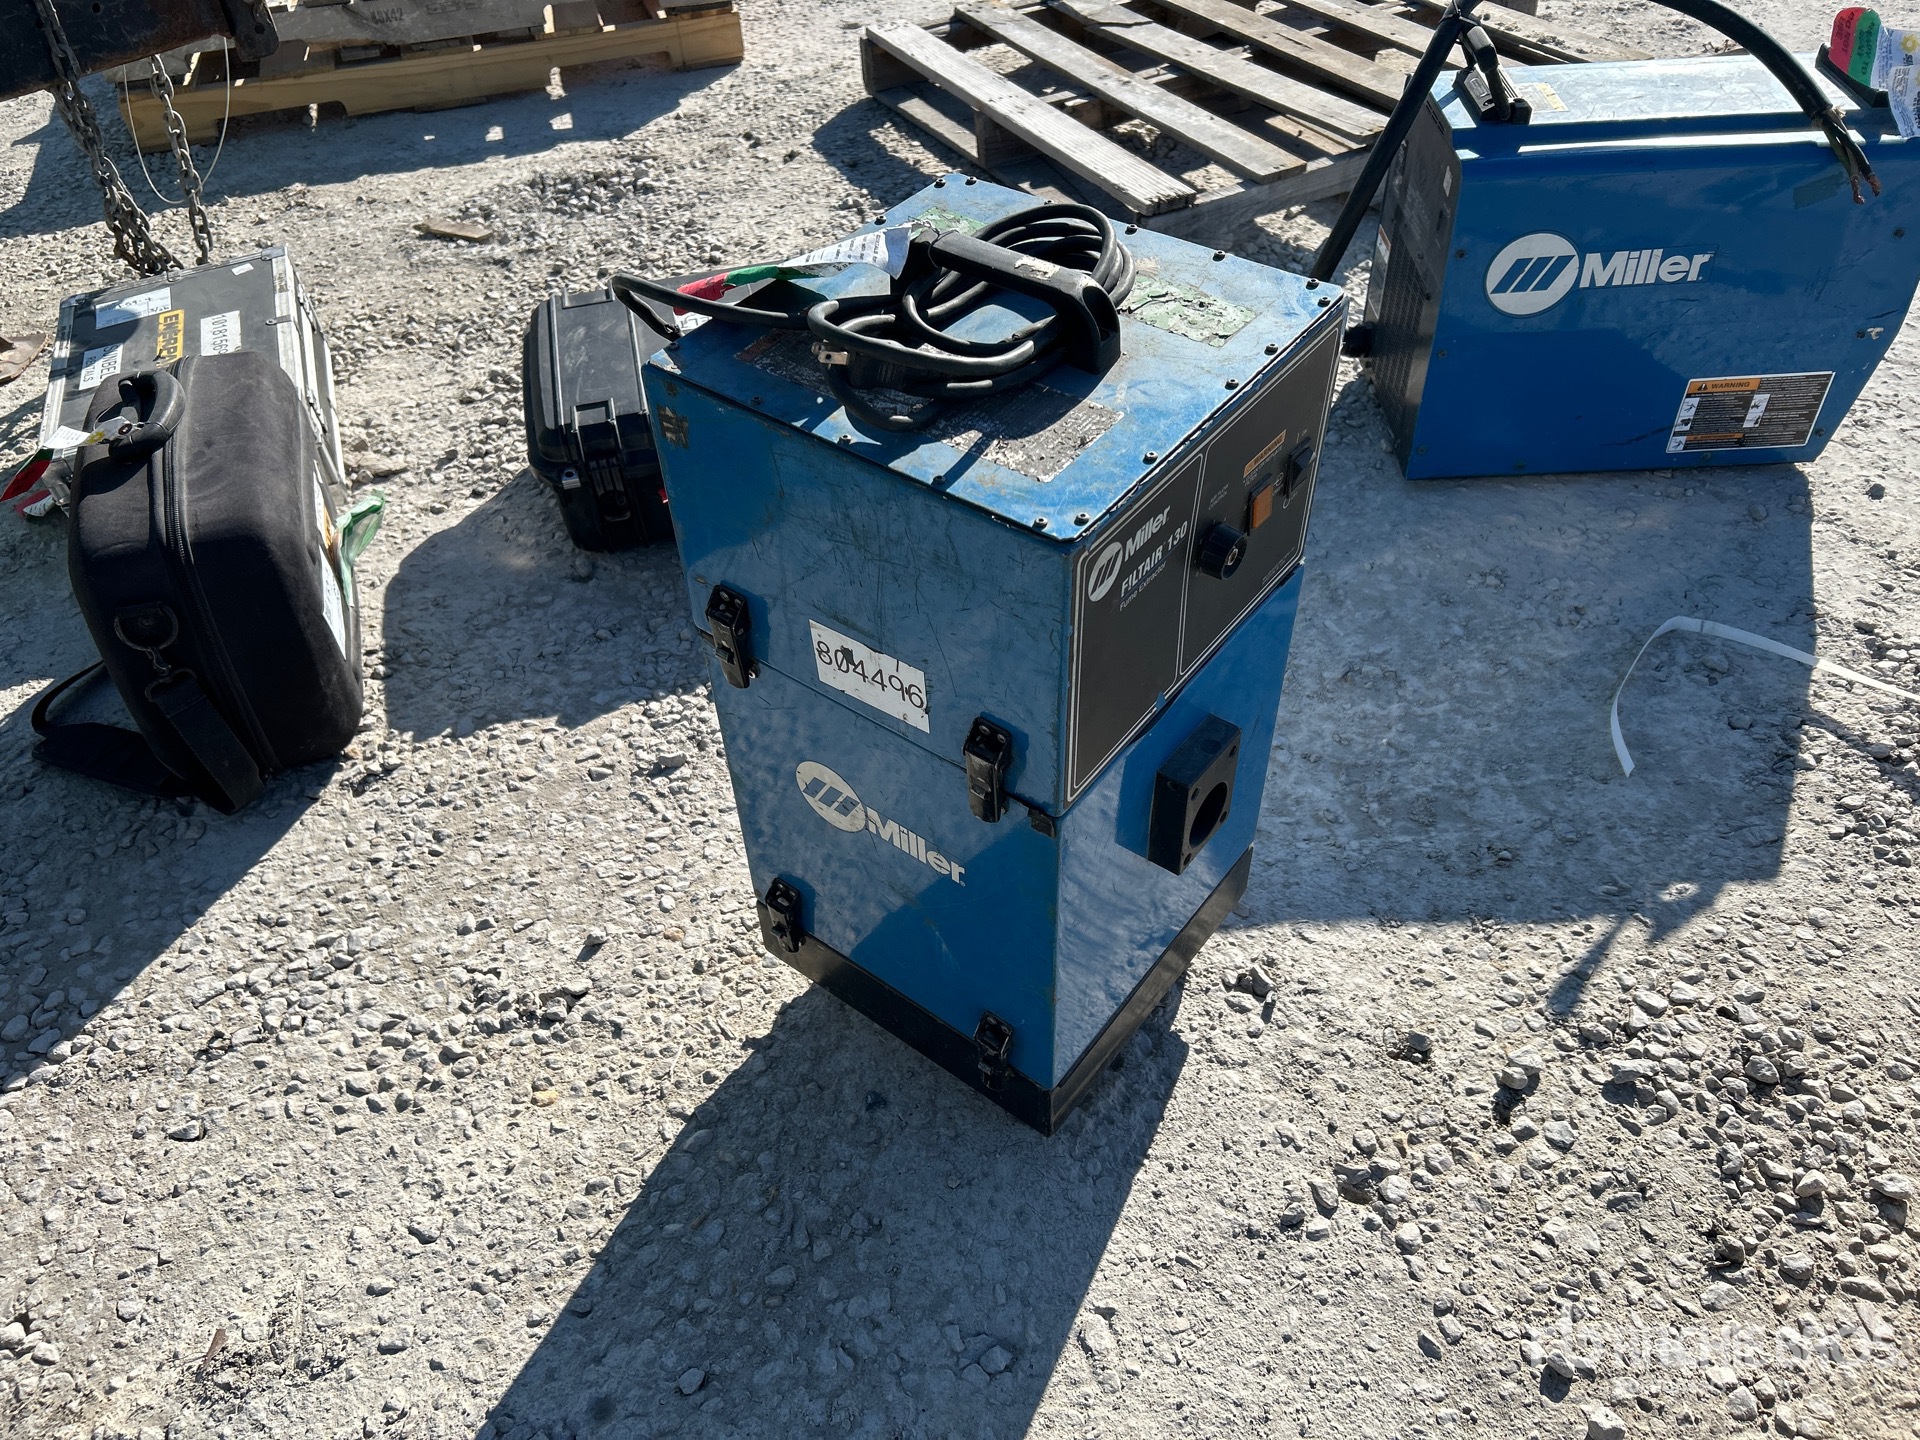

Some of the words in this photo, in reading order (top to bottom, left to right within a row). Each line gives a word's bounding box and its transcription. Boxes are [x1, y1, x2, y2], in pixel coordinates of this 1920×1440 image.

[1579, 248, 1714, 288] Miller
[100, 344, 119, 380] SUNBEL
[1120, 545, 1163, 598] FILTAIR
[1167, 521, 1188, 551] 130
[1124, 505, 1171, 562] Miller
[1119, 590, 1138, 612] Fume
[1139, 560, 1167, 593] Extractor
[816, 640, 924, 709] 804496
[866, 806, 966, 885] Miller
